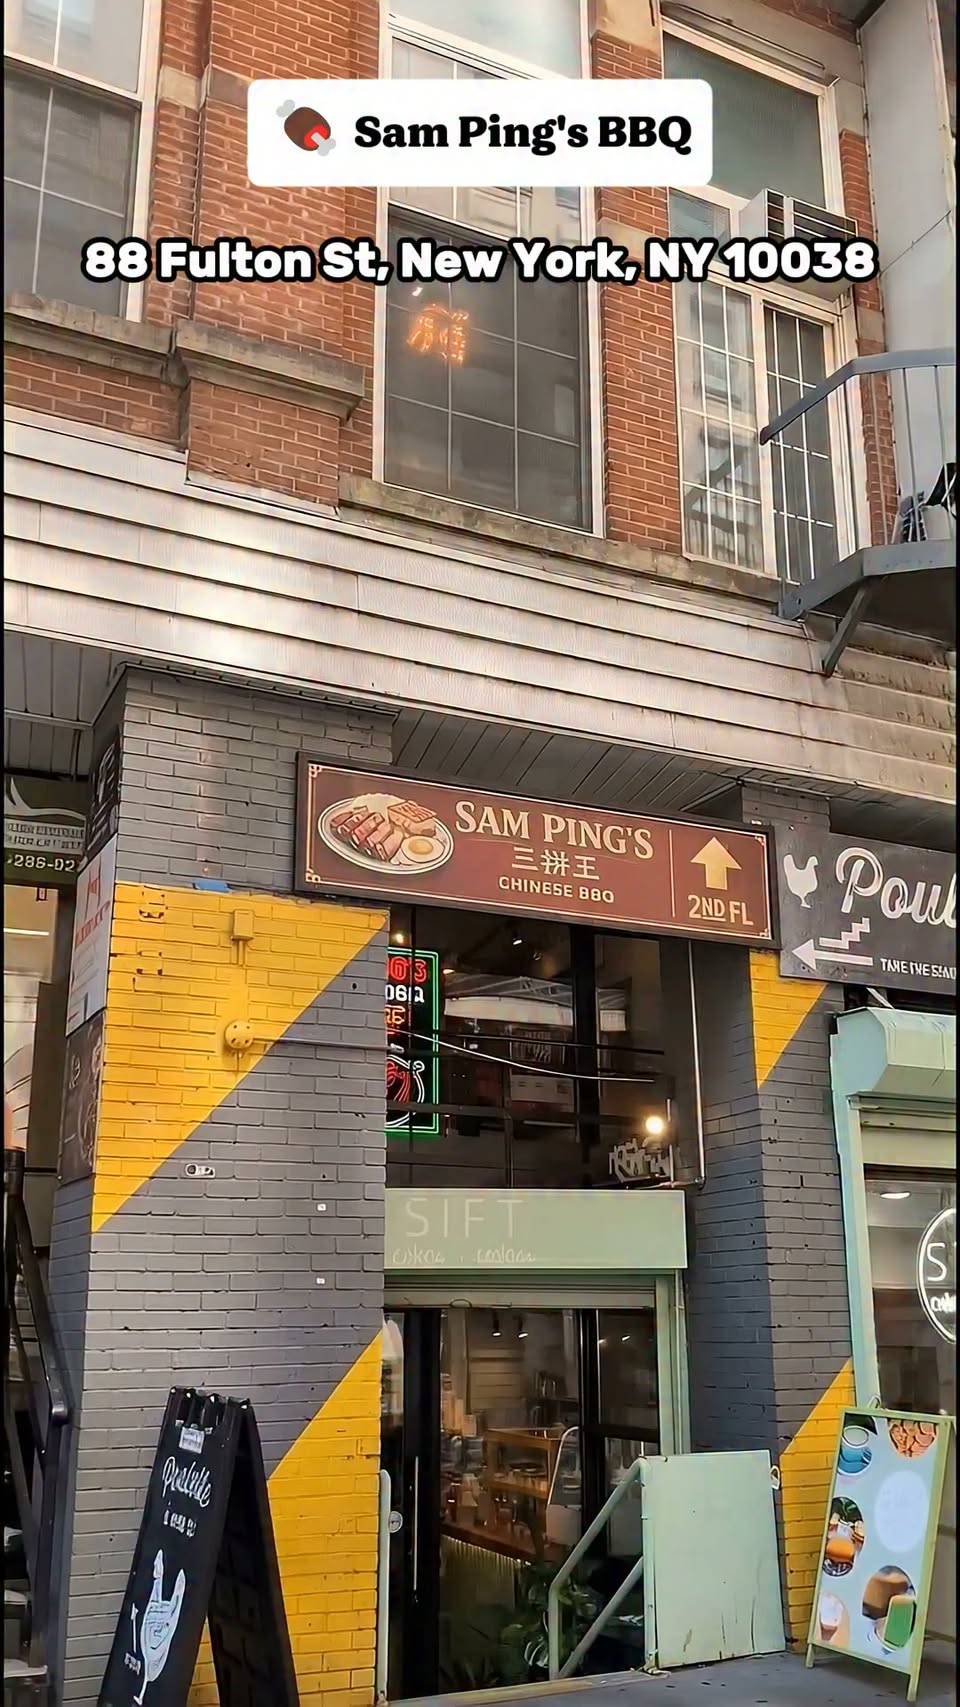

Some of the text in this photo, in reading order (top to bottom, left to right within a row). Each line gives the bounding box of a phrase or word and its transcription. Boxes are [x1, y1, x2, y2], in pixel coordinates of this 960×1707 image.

[454, 800, 654, 860] SAM PING'S
[511, 845, 601, 882] 三拼王
[498, 876, 616, 904] CHINESE BBQ
[687, 894, 755, 926] 2ND FL
[404, 1196, 525, 1239] SIFT
